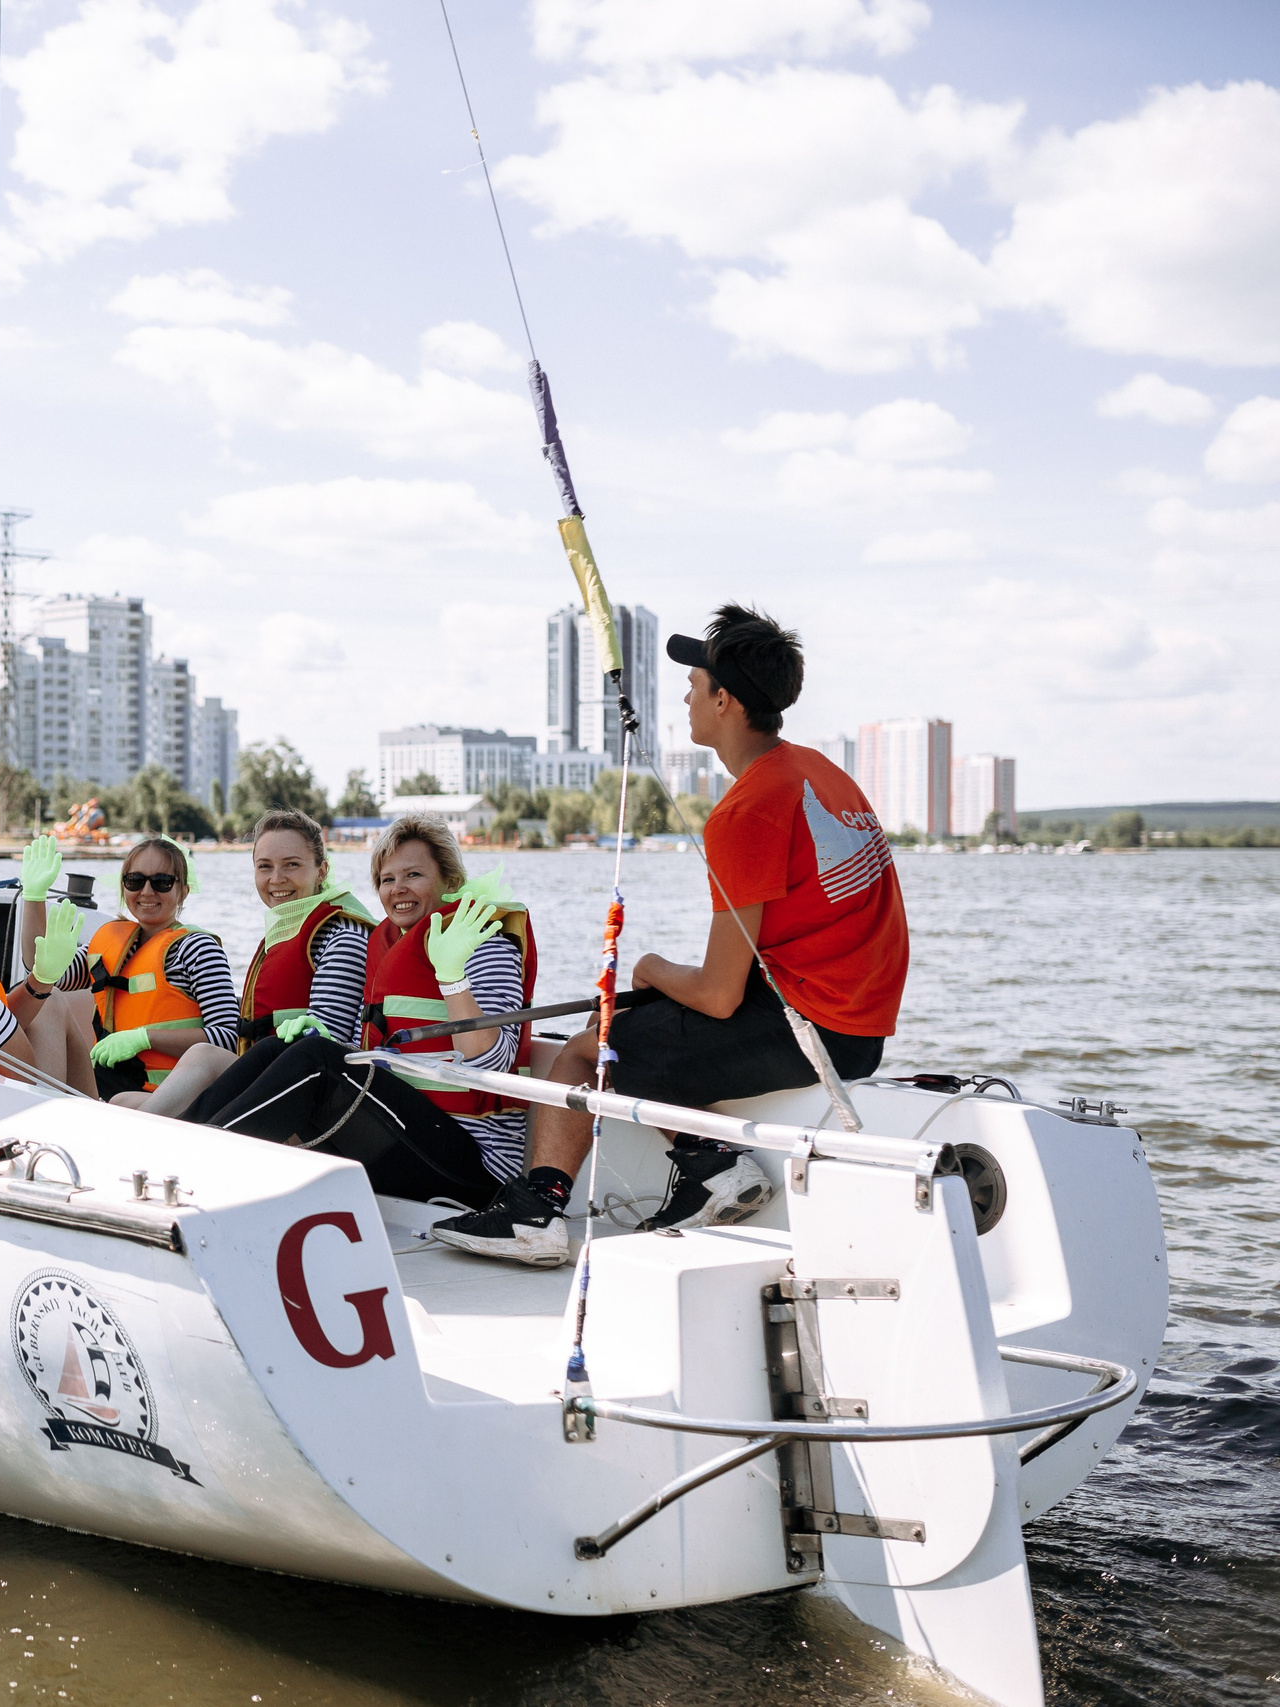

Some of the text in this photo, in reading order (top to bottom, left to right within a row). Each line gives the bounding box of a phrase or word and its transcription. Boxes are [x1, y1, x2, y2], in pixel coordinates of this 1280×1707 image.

[30, 1298, 60, 1372] GUBERNSKIY
[68, 1300, 108, 1339] YACHT
[277, 1211, 396, 1368] G
